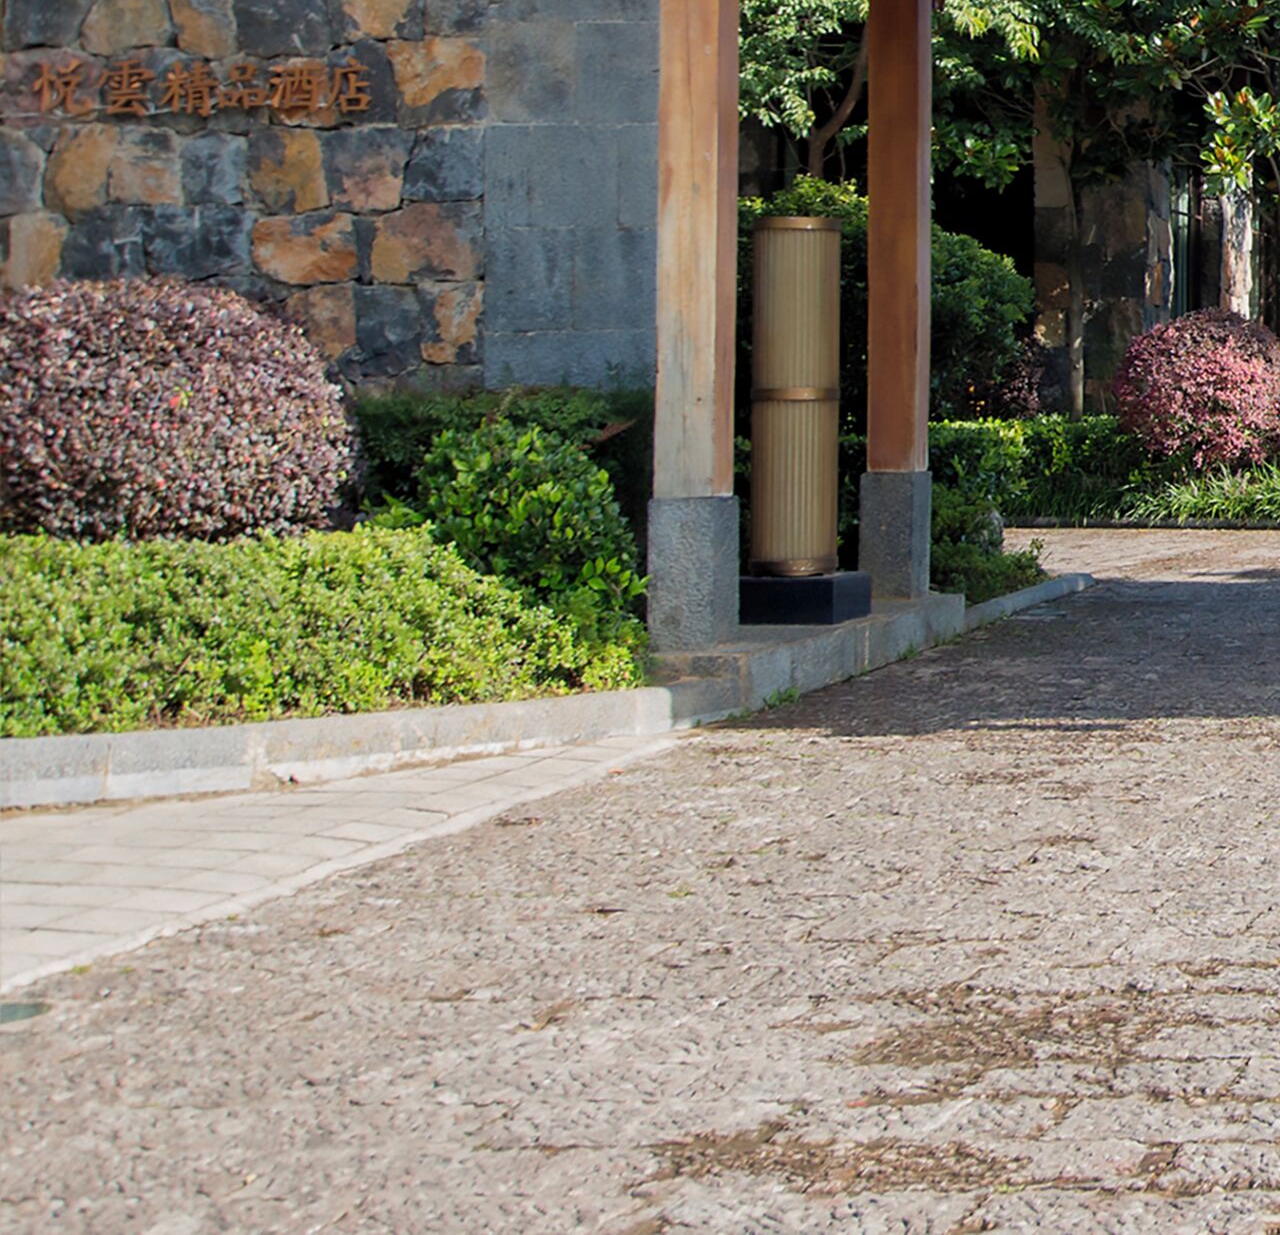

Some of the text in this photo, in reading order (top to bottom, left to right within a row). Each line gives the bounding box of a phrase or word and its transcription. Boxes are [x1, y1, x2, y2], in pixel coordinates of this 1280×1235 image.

[33, 57, 373, 118] 悦雲精品酒店
